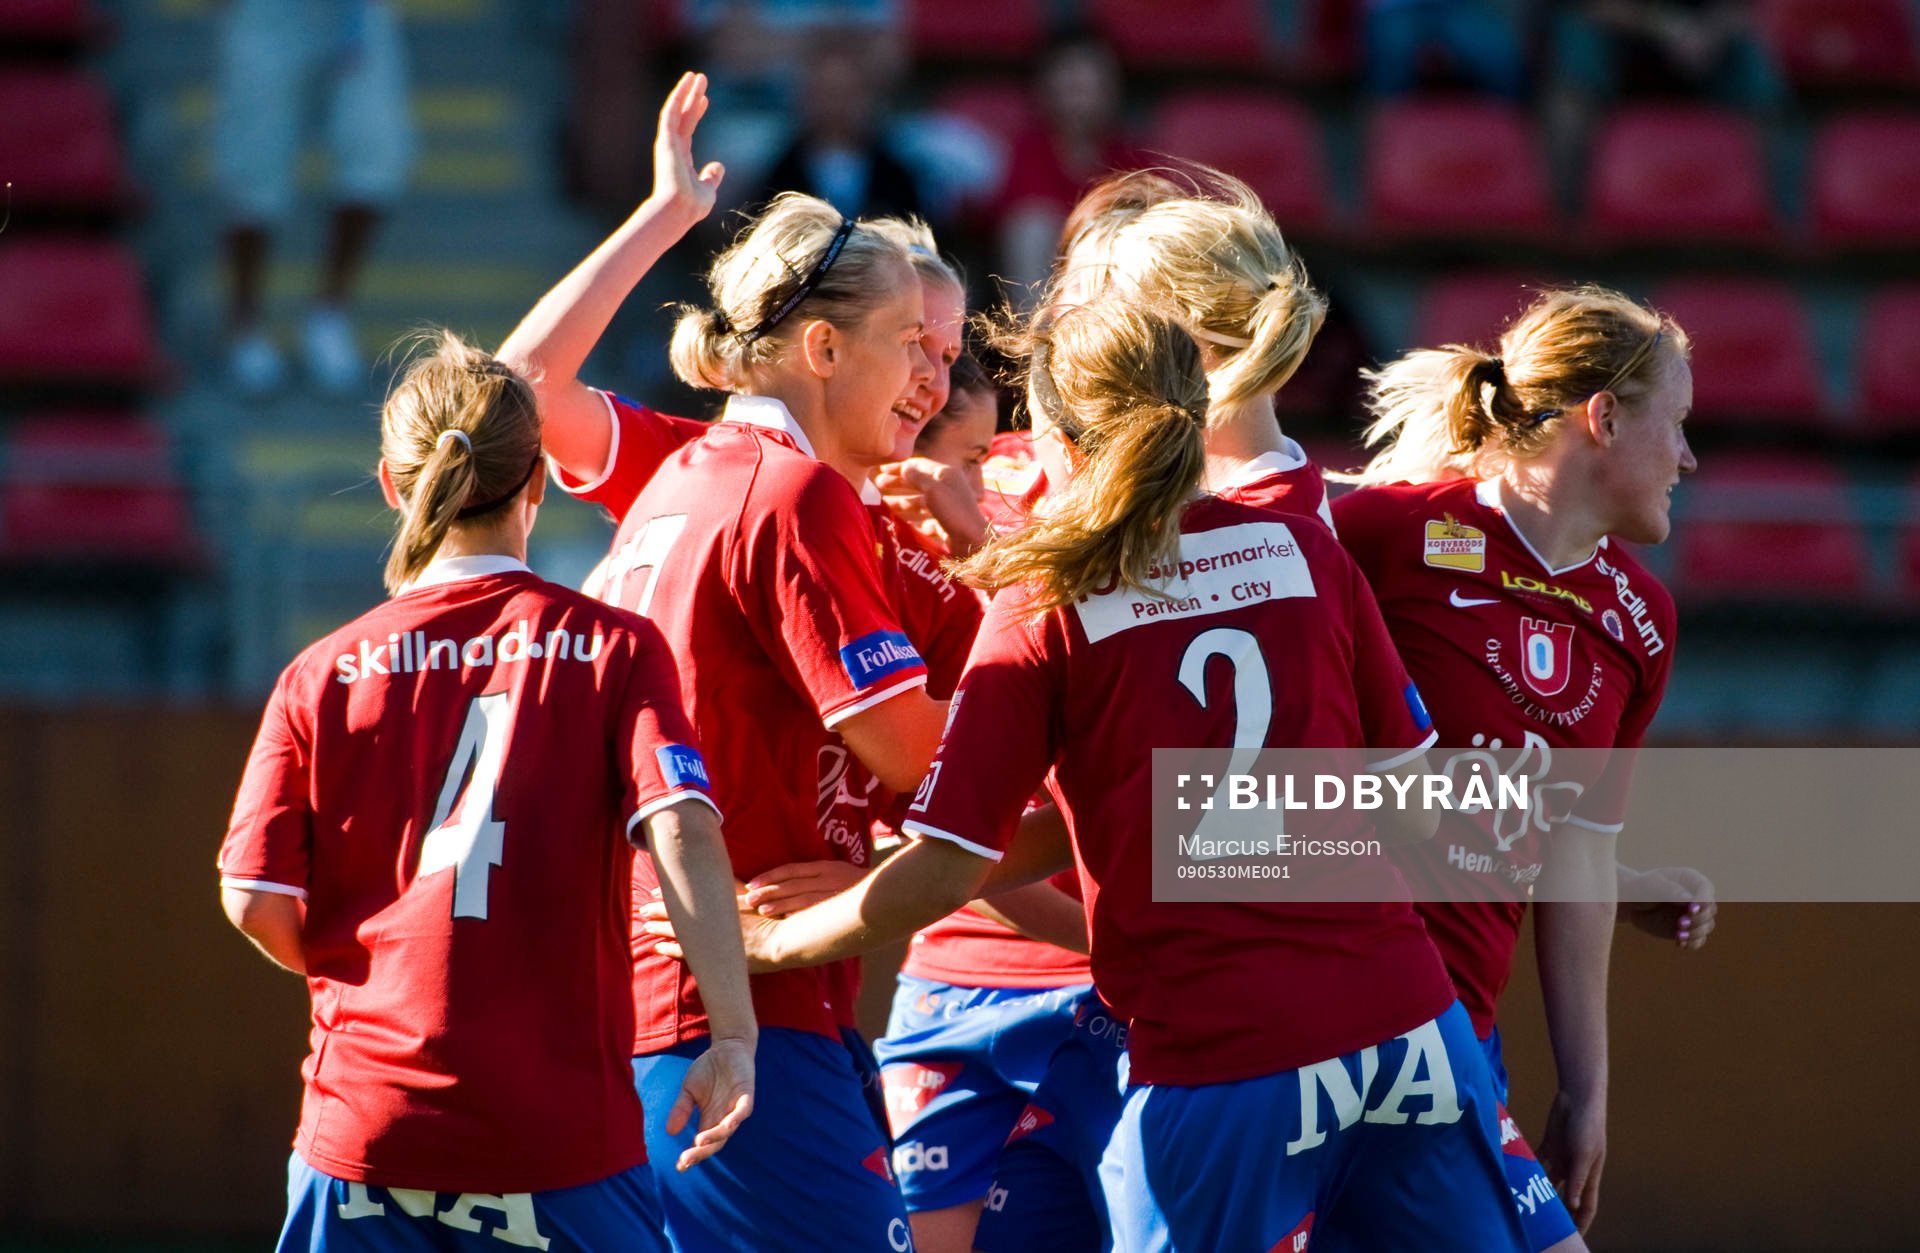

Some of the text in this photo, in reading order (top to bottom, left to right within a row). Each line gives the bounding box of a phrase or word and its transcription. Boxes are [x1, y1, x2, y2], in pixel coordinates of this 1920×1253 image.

[336, 620, 604, 685] skillnad.nu
[1131, 579, 1273, 619] Parken City
[1485, 638, 1602, 727] ÖREBRO UNIVERSITET
[1177, 626, 1286, 859] 2
[418, 692, 508, 921] 4
[1287, 1018, 1464, 1156] NA
